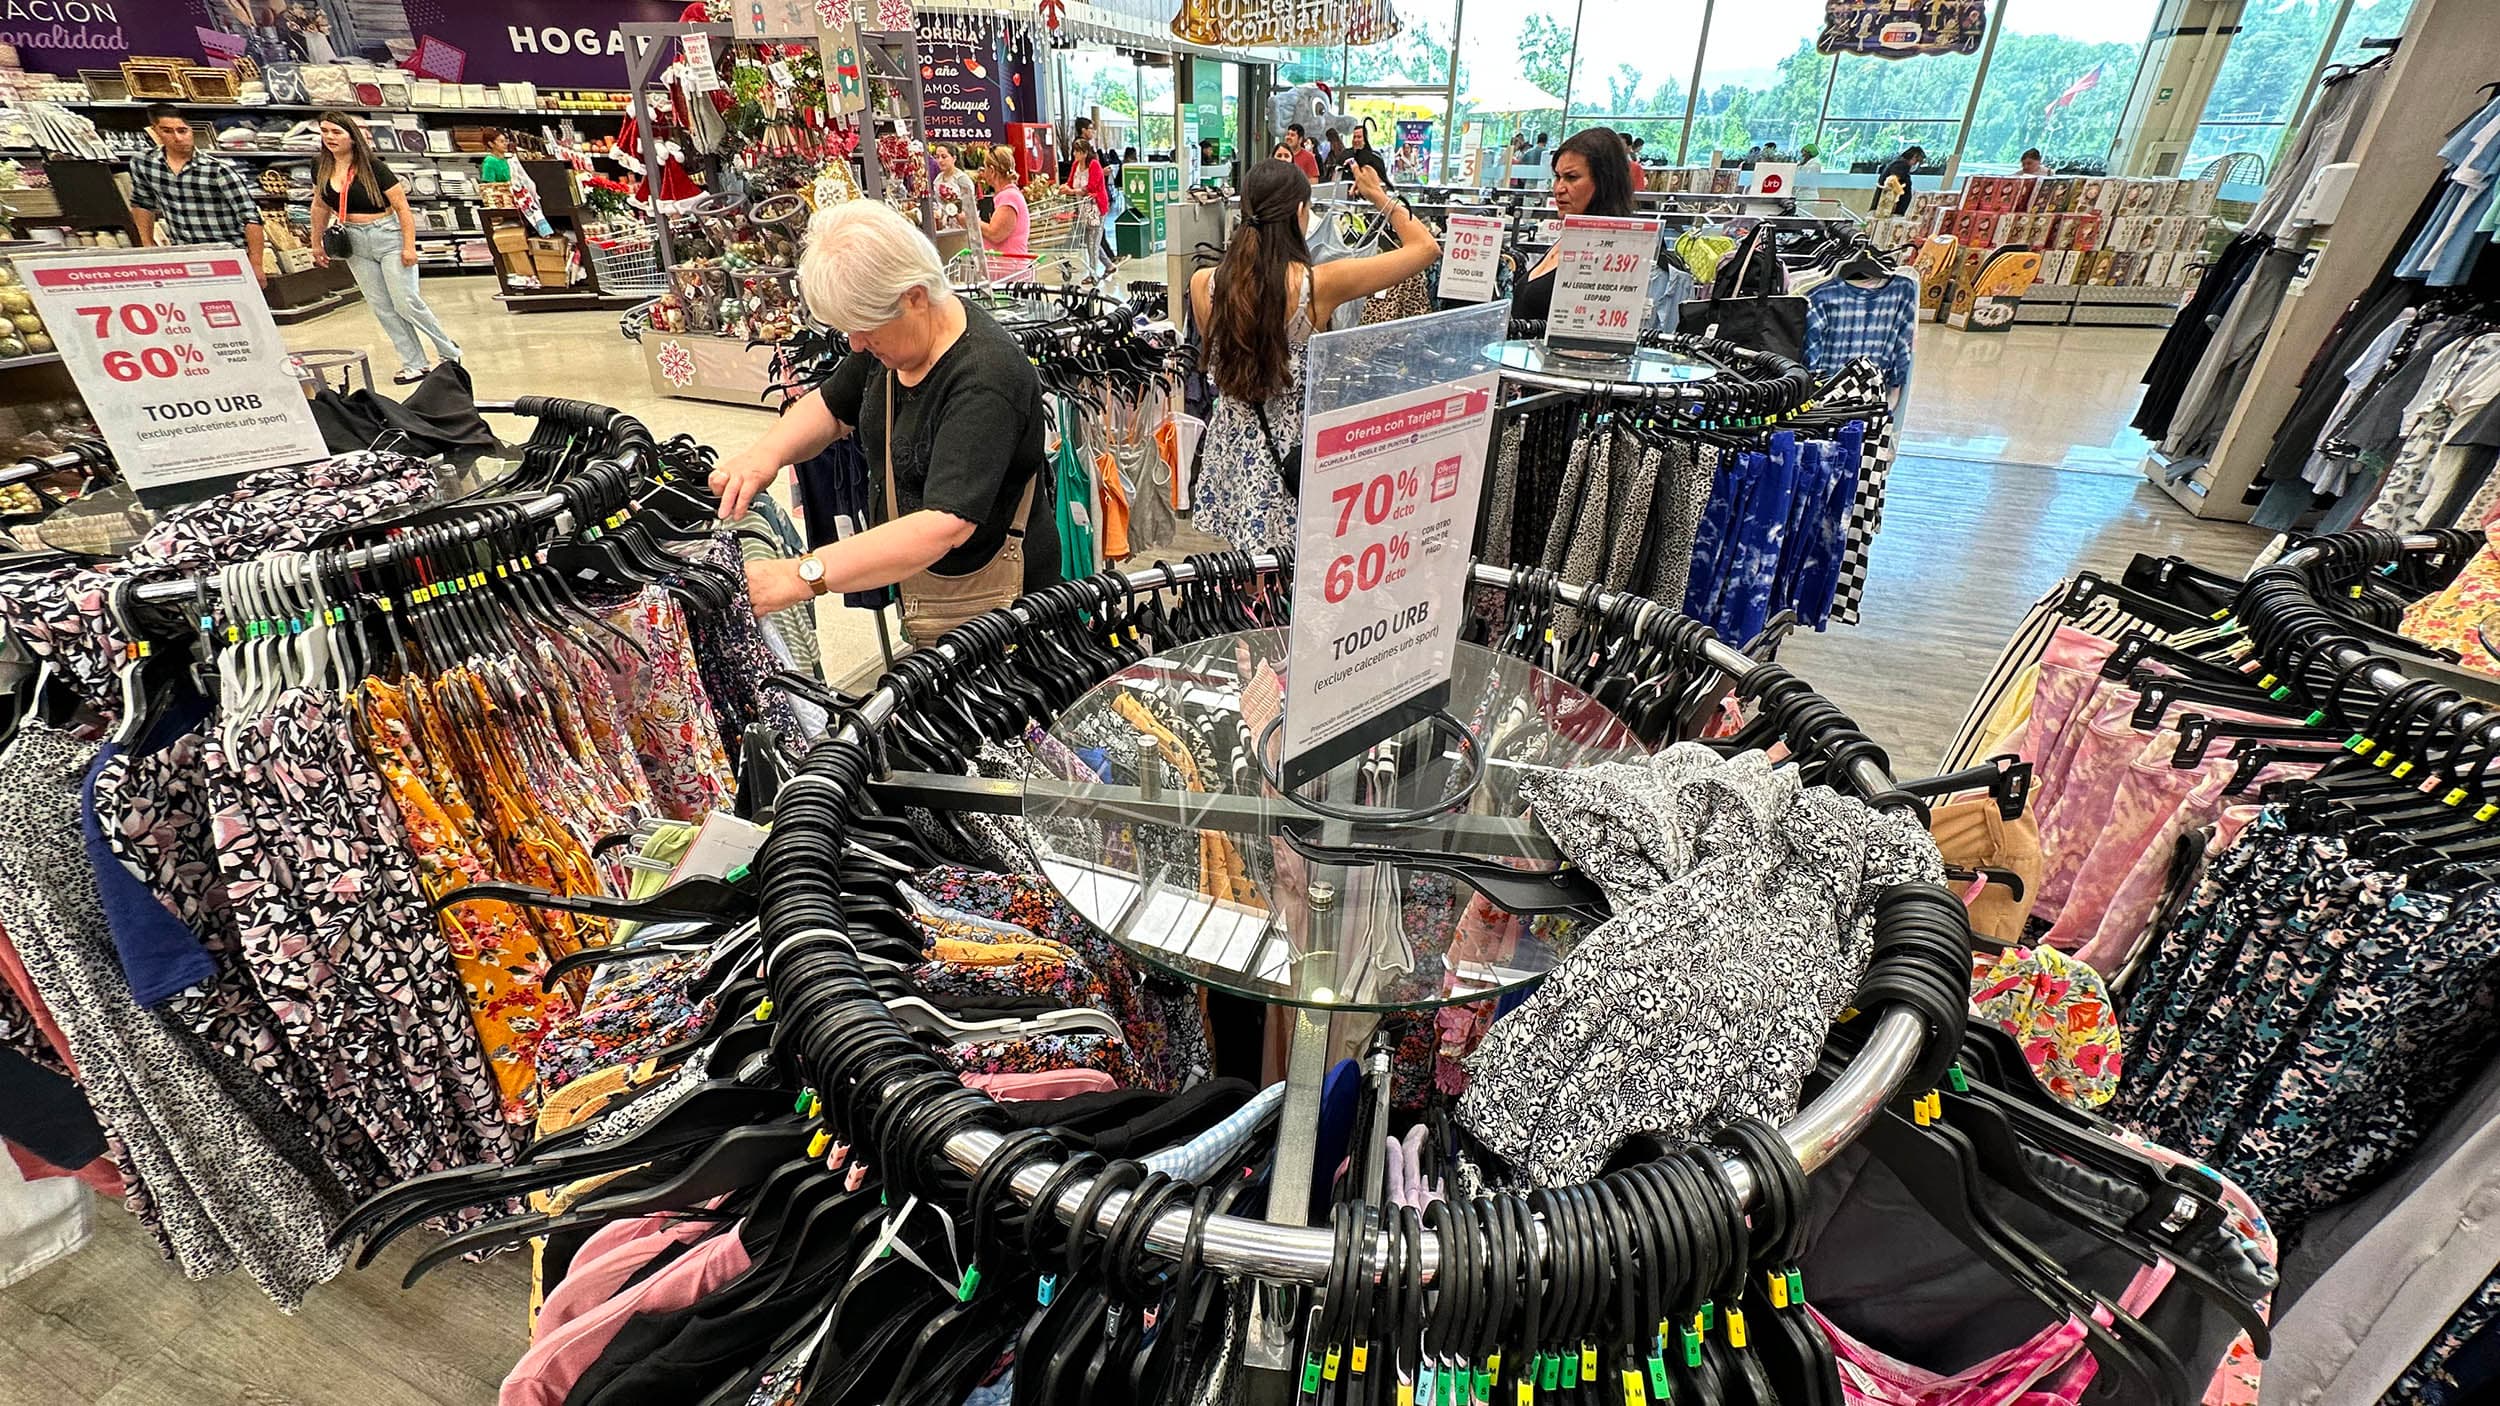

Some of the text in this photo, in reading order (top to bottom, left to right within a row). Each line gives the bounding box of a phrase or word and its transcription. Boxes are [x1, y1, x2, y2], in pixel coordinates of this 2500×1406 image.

[935, 65, 960, 76] año
[924, 84, 960, 94] AMOS
[940, 97, 990, 114] Bouquet
[934, 128, 992, 138] FRESCAS
[1463, 160, 1474, 176] 3
[1602, 254, 1639, 272] 2.397
[68, 270, 111, 281] Oferta
[114, 270, 137, 278] con
[140, 266, 184, 277] Tarjeta
[1584, 294, 1611, 302] LEOPARD
[1597, 309, 1629, 328] 3.196
[165, 324, 191, 336] dcto
[184, 366, 210, 378] dcto
[142, 394, 263, 422] TODO URB
[137, 413, 288, 442] (excluye calcetines urb sport)
[1345, 424, 1381, 442] Oferta
[1384, 419, 1405, 433] con
[1407, 407, 1442, 426] Tarjeta
[1393, 504, 1415, 520] dcto
[1422, 518, 1451, 536] CON OTRO
[1425, 544, 1442, 555] PAGO
[1384, 568, 1406, 584] dcto
[1333, 600, 1429, 661] TODO URB
[1314, 625, 1439, 694] (excluye calcetines urb sport)
[1656, 1373, 1663, 1382] S
[1481, 1387, 1486, 1395] S
